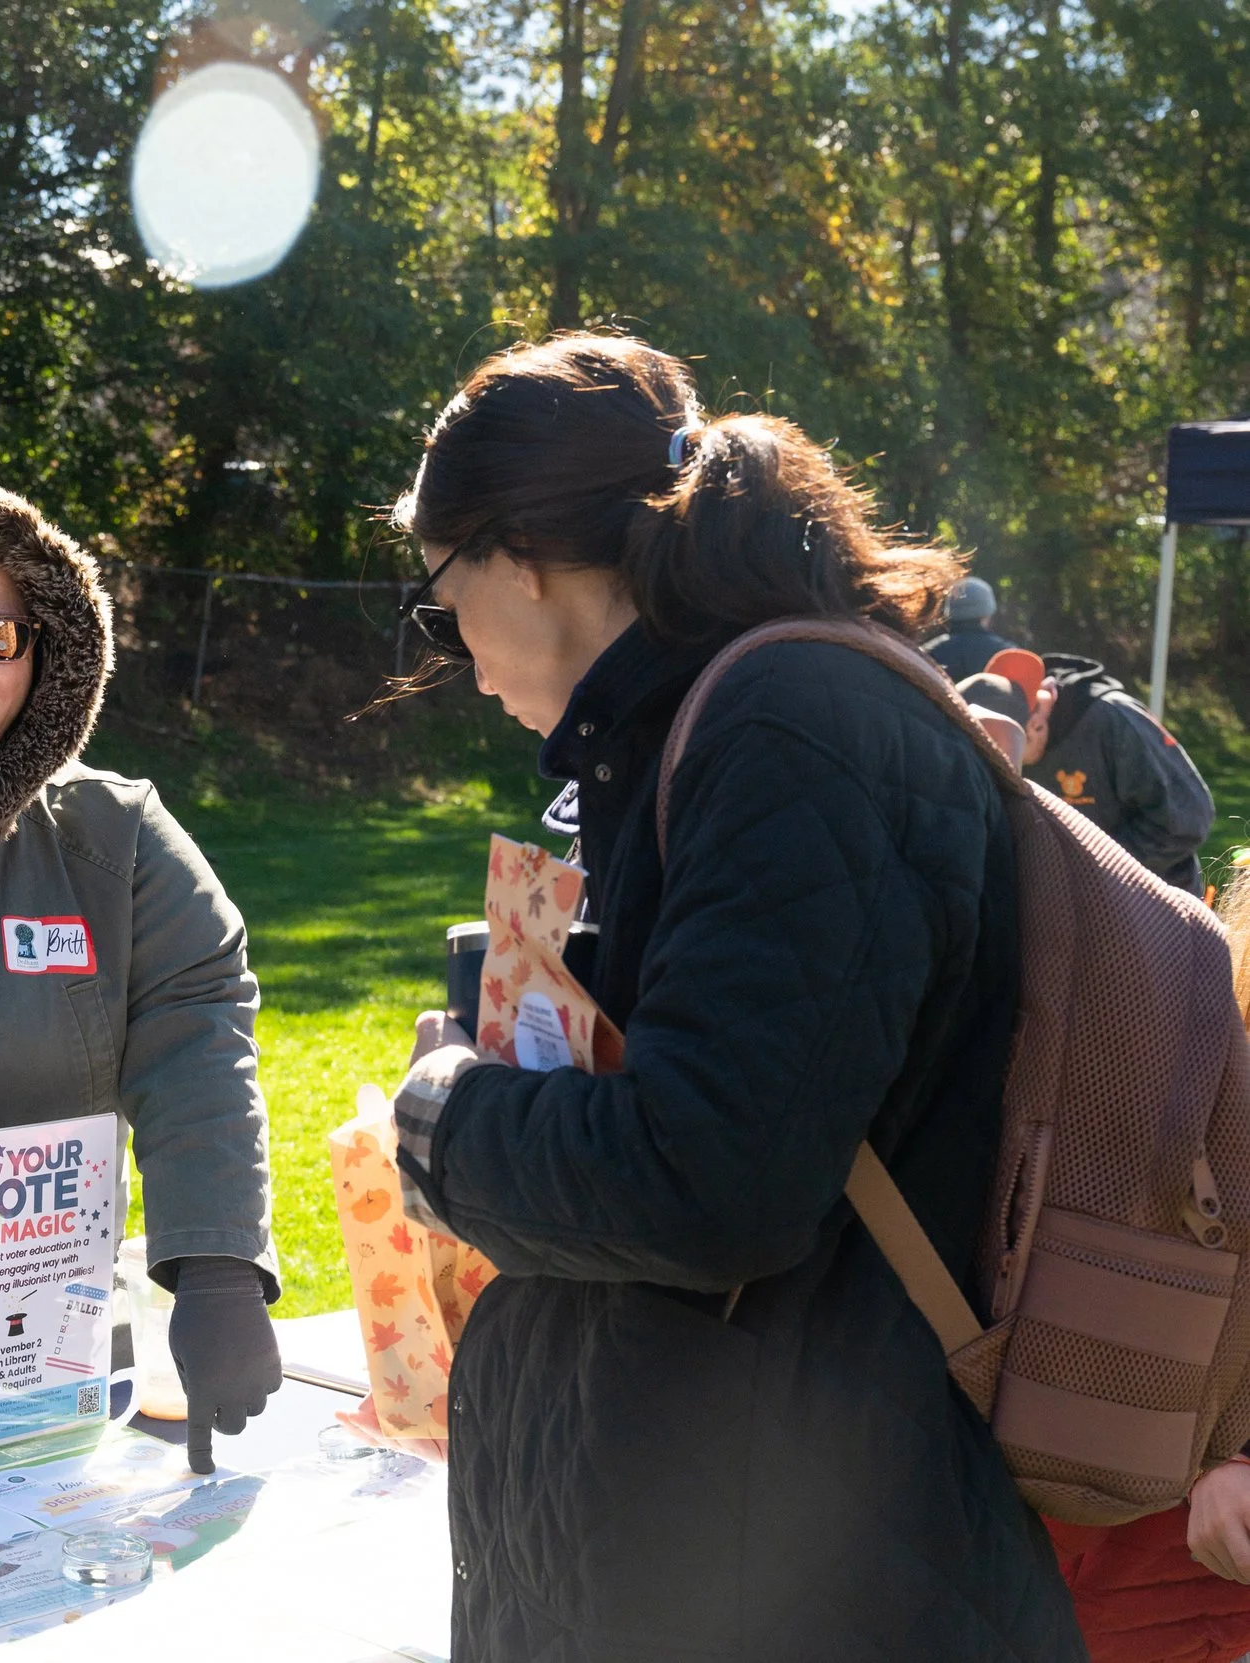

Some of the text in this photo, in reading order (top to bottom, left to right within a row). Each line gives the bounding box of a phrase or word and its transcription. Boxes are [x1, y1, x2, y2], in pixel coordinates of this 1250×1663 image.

[46, 927, 87, 957] Britt
[6, 1139, 83, 1176] YOUR
[0, 1211, 76, 1244] MAGIC
[6, 1249, 28, 1261] voter
[29, 1241, 72, 1256] education
[73, 1239, 84, 1249] in
[83, 1238, 90, 1247] a
[0, 1262, 41, 1278] engaging
[42, 1259, 60, 1270] way
[61, 1254, 79, 1266] with
[12, 1275, 51, 1289] illusionist
[52, 1271, 67, 1283] Lyn
[66, 1300, 105, 1317] BALLOT
[37, 1338, 43, 1348] 2
[5, 1352, 37, 1367] Library
[7, 1364, 37, 1377] Adults
[2, 1374, 43, 1391] Required
